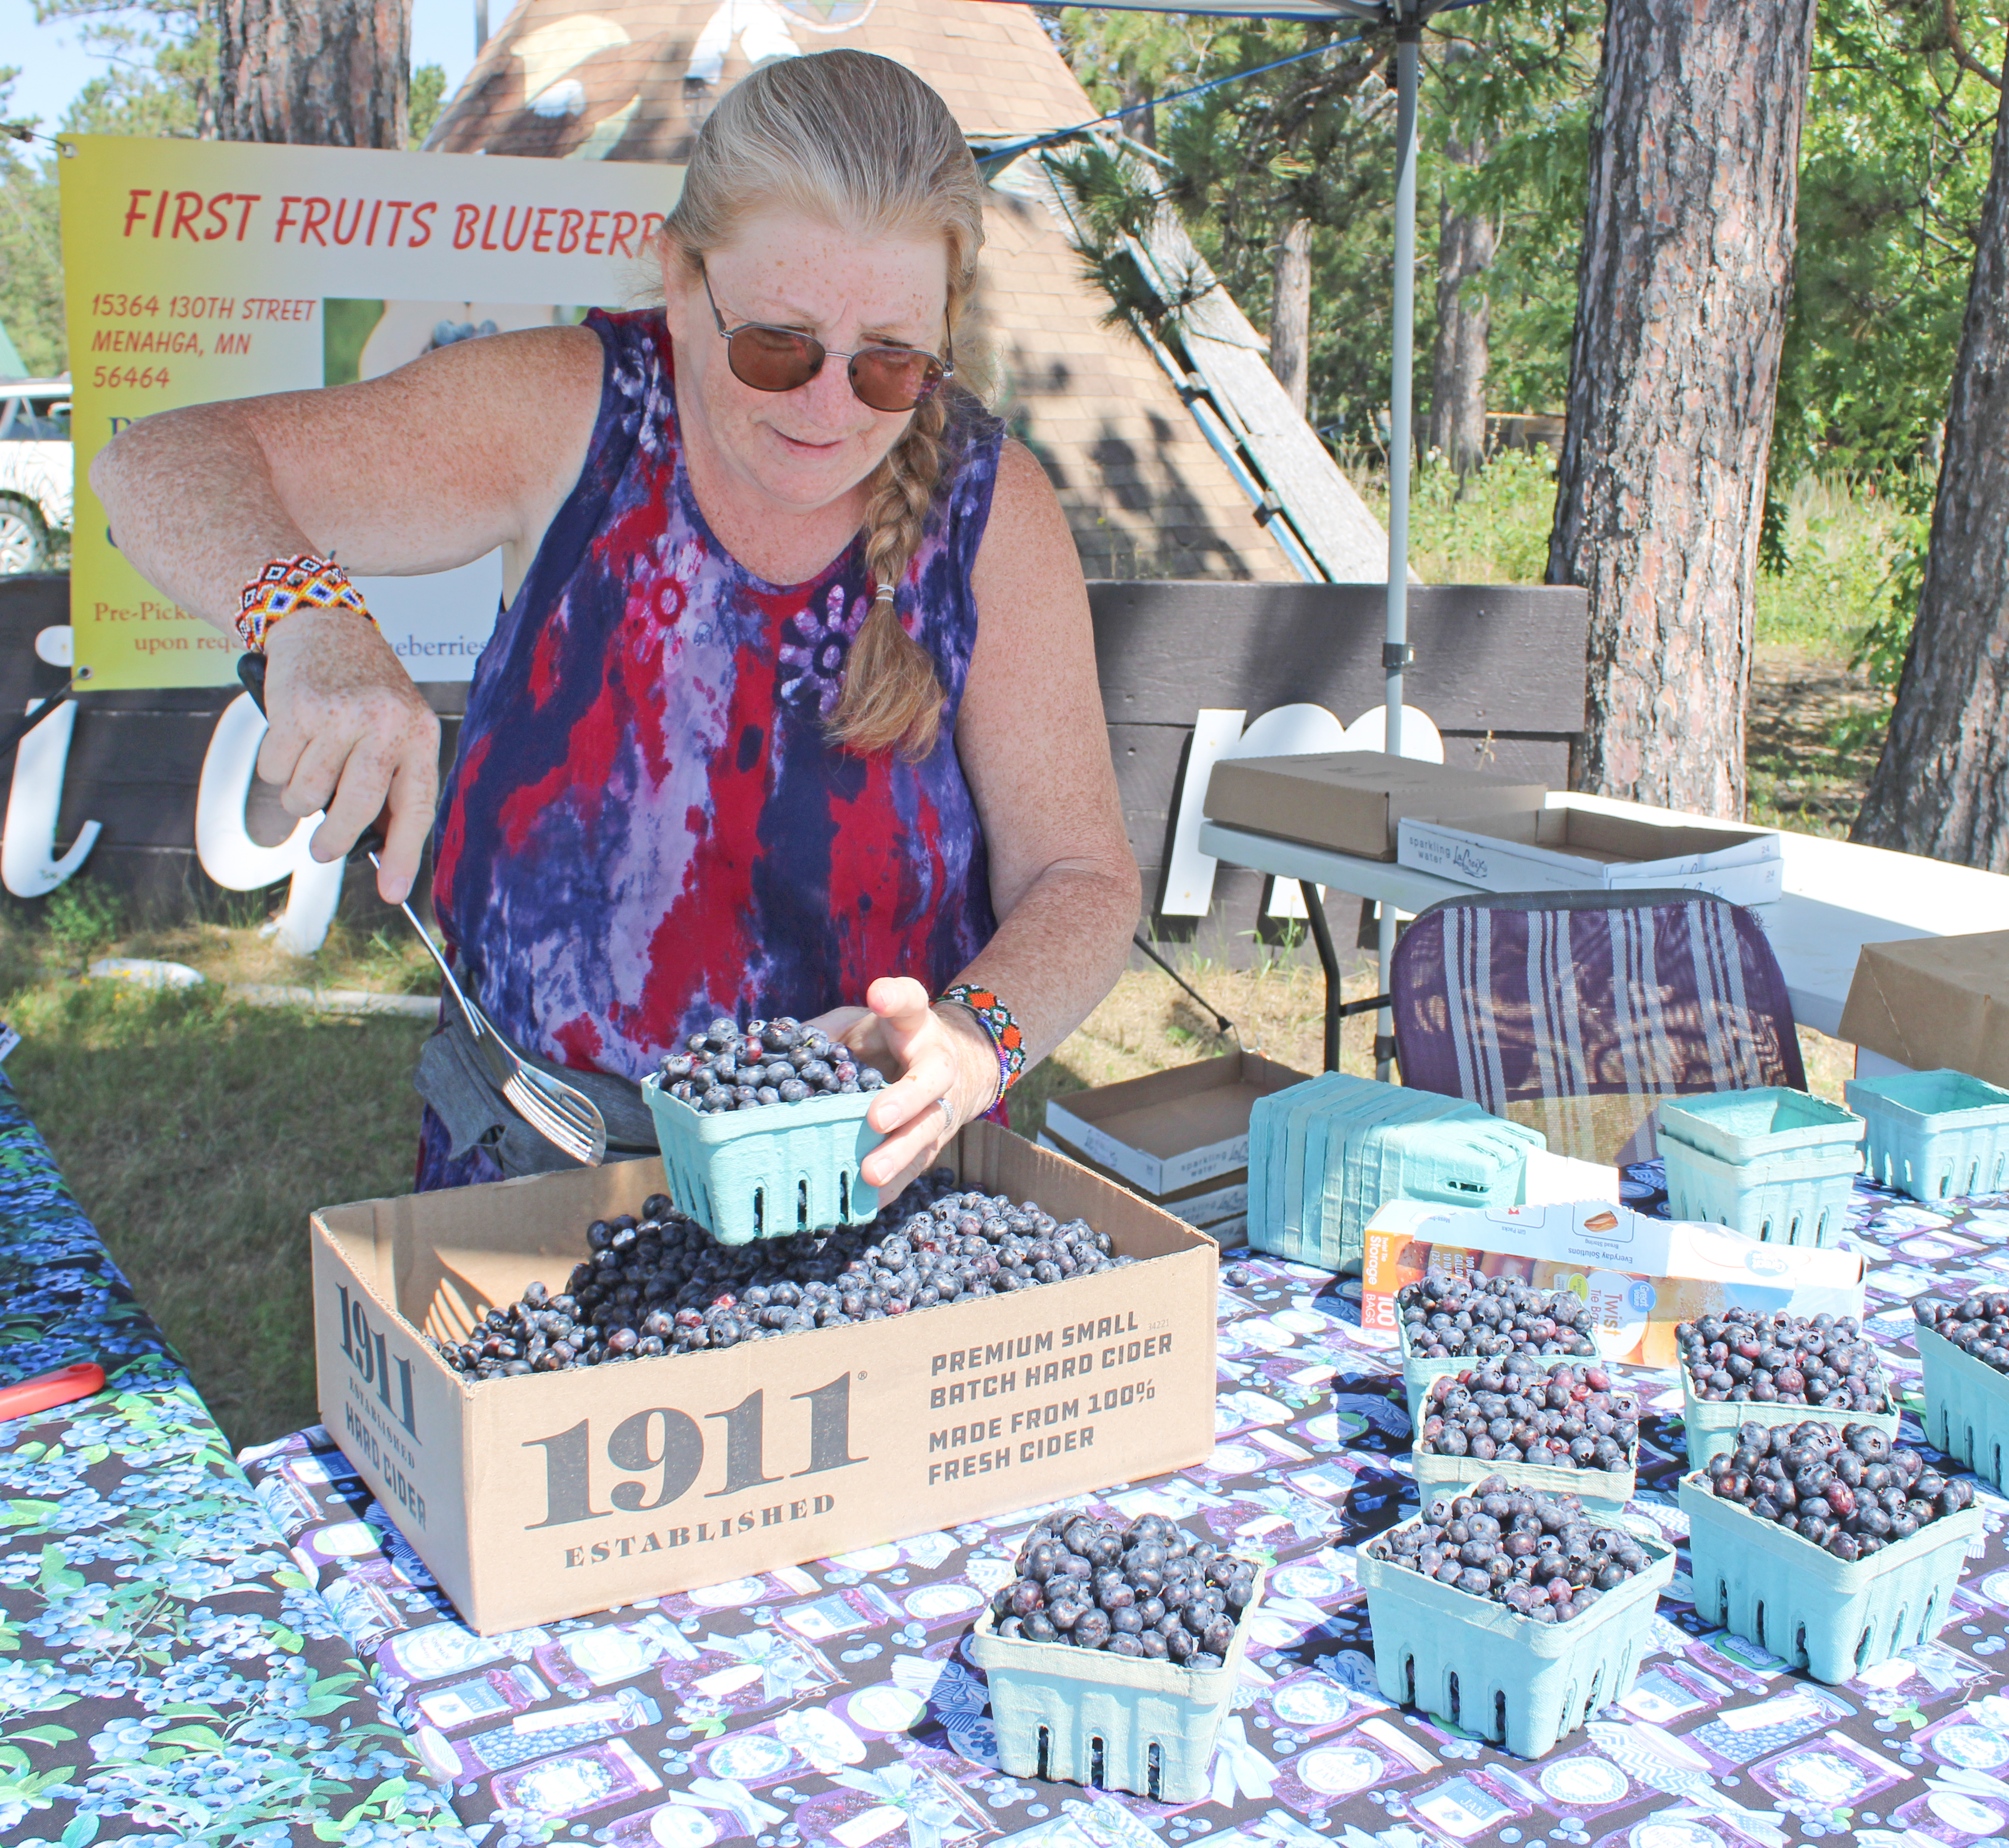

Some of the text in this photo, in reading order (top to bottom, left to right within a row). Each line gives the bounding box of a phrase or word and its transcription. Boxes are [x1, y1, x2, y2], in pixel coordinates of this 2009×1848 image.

[123, 189, 261, 242] FIRST
[275, 197, 438, 248] FRUITS
[92, 294, 316, 322] 15364 130TH STREET
[91, 330, 251, 357] MENAHGA, MN
[93, 366, 169, 389] 56464
[135, 637, 189, 655] upon
[1409, 837, 1451, 859] sparkling
[1418, 850, 1442, 864] water
[1501, 1225, 1516, 1234] Packs
[1584, 1238, 1619, 1250] Bread Storing
[1366, 1235, 1382, 1285] Storage
[1466, 1256, 1475, 1269] 100
[1567, 1247, 1633, 1264] Everyday Solutions
[1365, 1293, 1376, 1324] BAGS
[1591, 1289, 1601, 1303] Tie
[1639, 1285, 1650, 1308] Great
[1377, 1296, 1397, 1327] 100
[1604, 1293, 1623, 1336] Twist
[931, 1311, 1139, 1376] PREMIUM SMALL
[335, 1282, 423, 1447] 1911
[930, 1333, 1173, 1409] BATCH HARD CIDER
[348, 1376, 416, 1469] ESTABLISHED
[929, 1378, 1156, 1453] MADE FROM 100%
[346, 1400, 380, 1471] HARD
[383, 1451, 428, 1532] CIDER
[928, 1426, 1095, 1486] FRESH CIDER
[564, 1494, 836, 1569] ESTABLISHED
[1460, 1798, 1488, 1818] JAM
